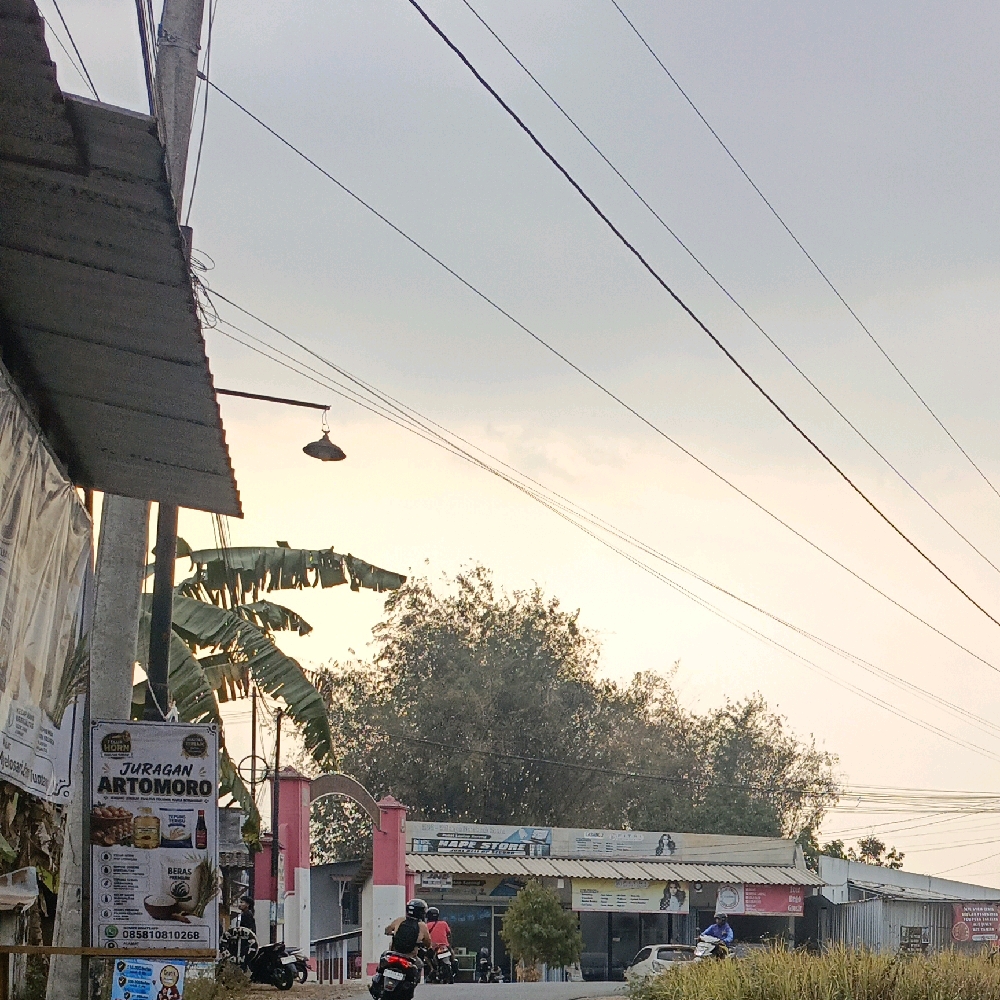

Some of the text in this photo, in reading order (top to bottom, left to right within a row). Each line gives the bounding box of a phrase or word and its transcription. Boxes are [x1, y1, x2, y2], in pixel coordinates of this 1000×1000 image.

[120, 762, 194, 777] JURAGAN
[98, 776, 213, 797] ARTOMORO
[480, 842, 526, 851] STORE
[168, 867, 192, 875] BERAS
[122, 931, 200, 939] 085810810268
